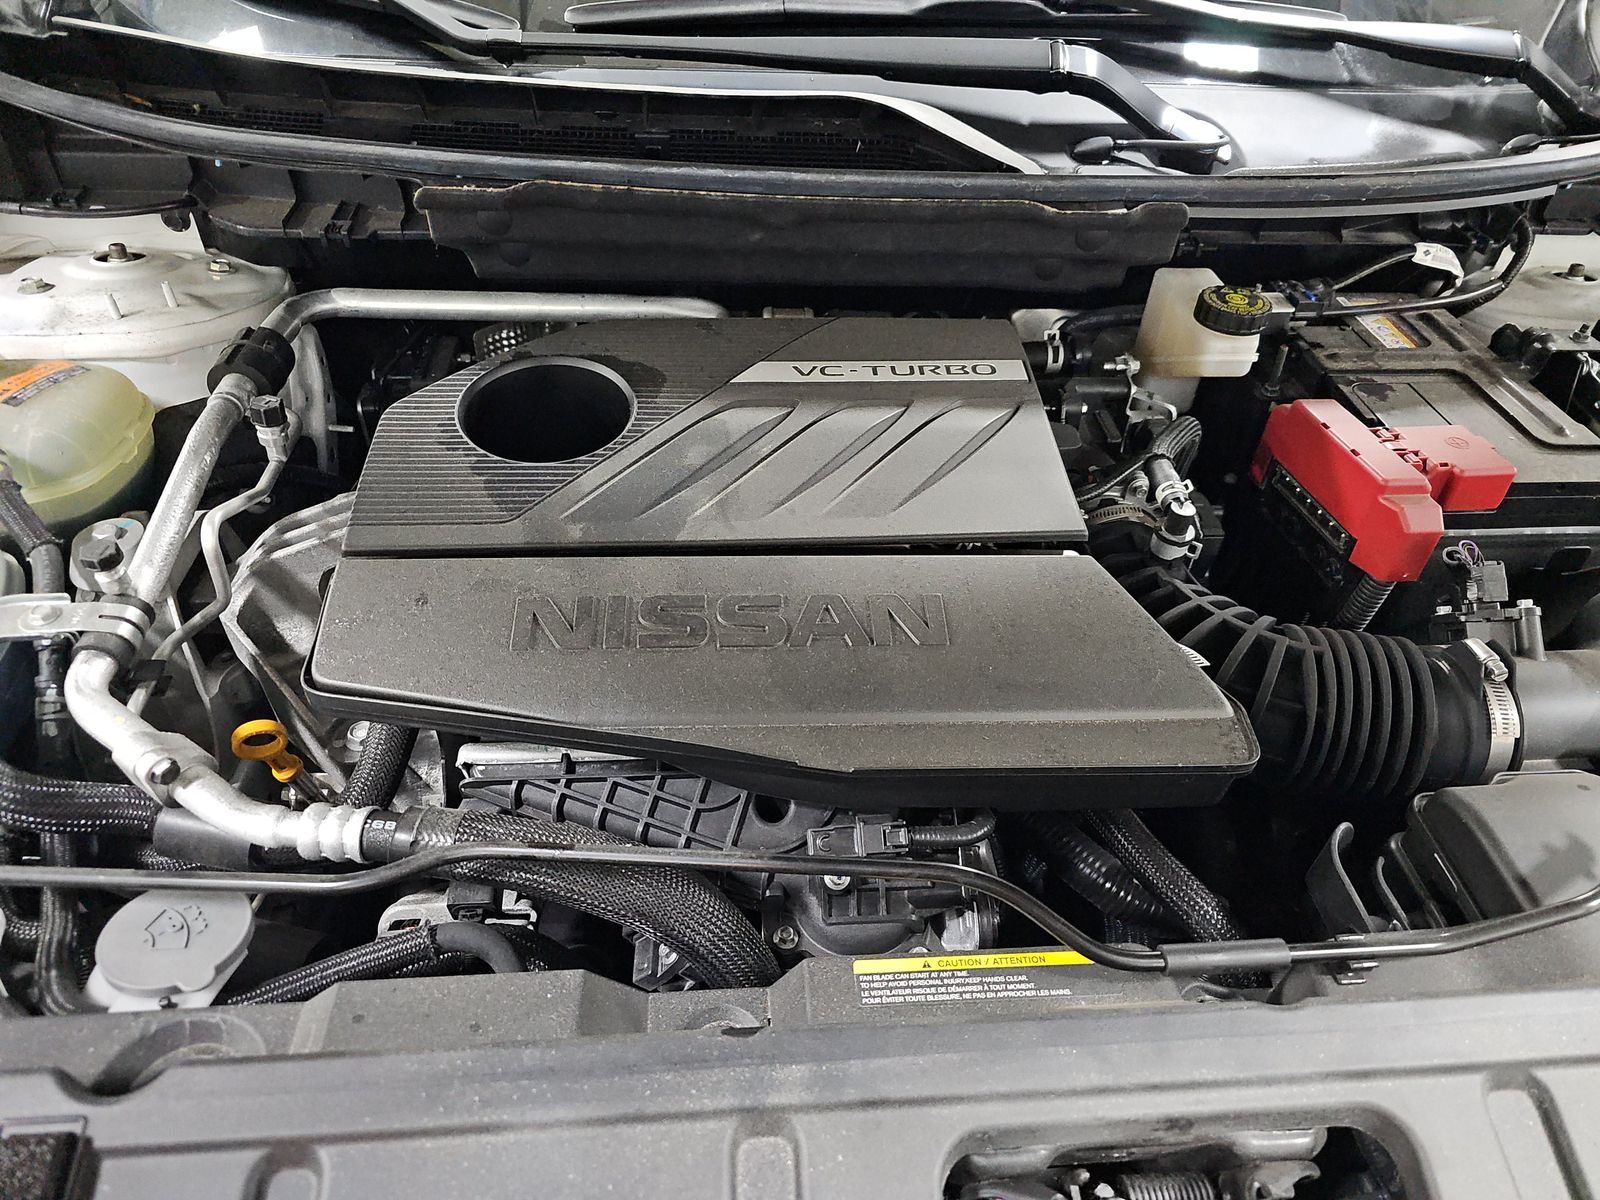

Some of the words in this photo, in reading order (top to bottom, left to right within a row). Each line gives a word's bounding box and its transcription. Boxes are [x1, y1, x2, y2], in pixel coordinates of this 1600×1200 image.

[791, 363, 998, 377] VC-TURBO
[509, 593, 951, 651] NISSAN
[937, 958, 982, 968] CAUTION
[992, 955, 1047, 965] ATTENTION
[873, 973, 894, 981] BLADE
[895, 972, 909, 980] CAN
[910, 971, 929, 979] START
[909, 978, 943, 986] PERSONAL
[982, 975, 1005, 983] HANDS
[1005, 974, 1028, 982] CLEAR.
[870, 987, 912, 997] VENTILATEUR
[912, 987, 937, 995] RISQUE
[947, 984, 983, 993] DÉMARRER
[983, 983, 989, 991] À
[989, 983, 1006, 991] TOUT
[1006, 982, 1036, 990] MOMENT.
[882, 995, 904, 1004] ÉVITER
[926, 993, 962, 1001] BLESSURE,
[996, 989, 1037, 998] APPROCHER
[1049, 988, 1072, 996] MAINS.
